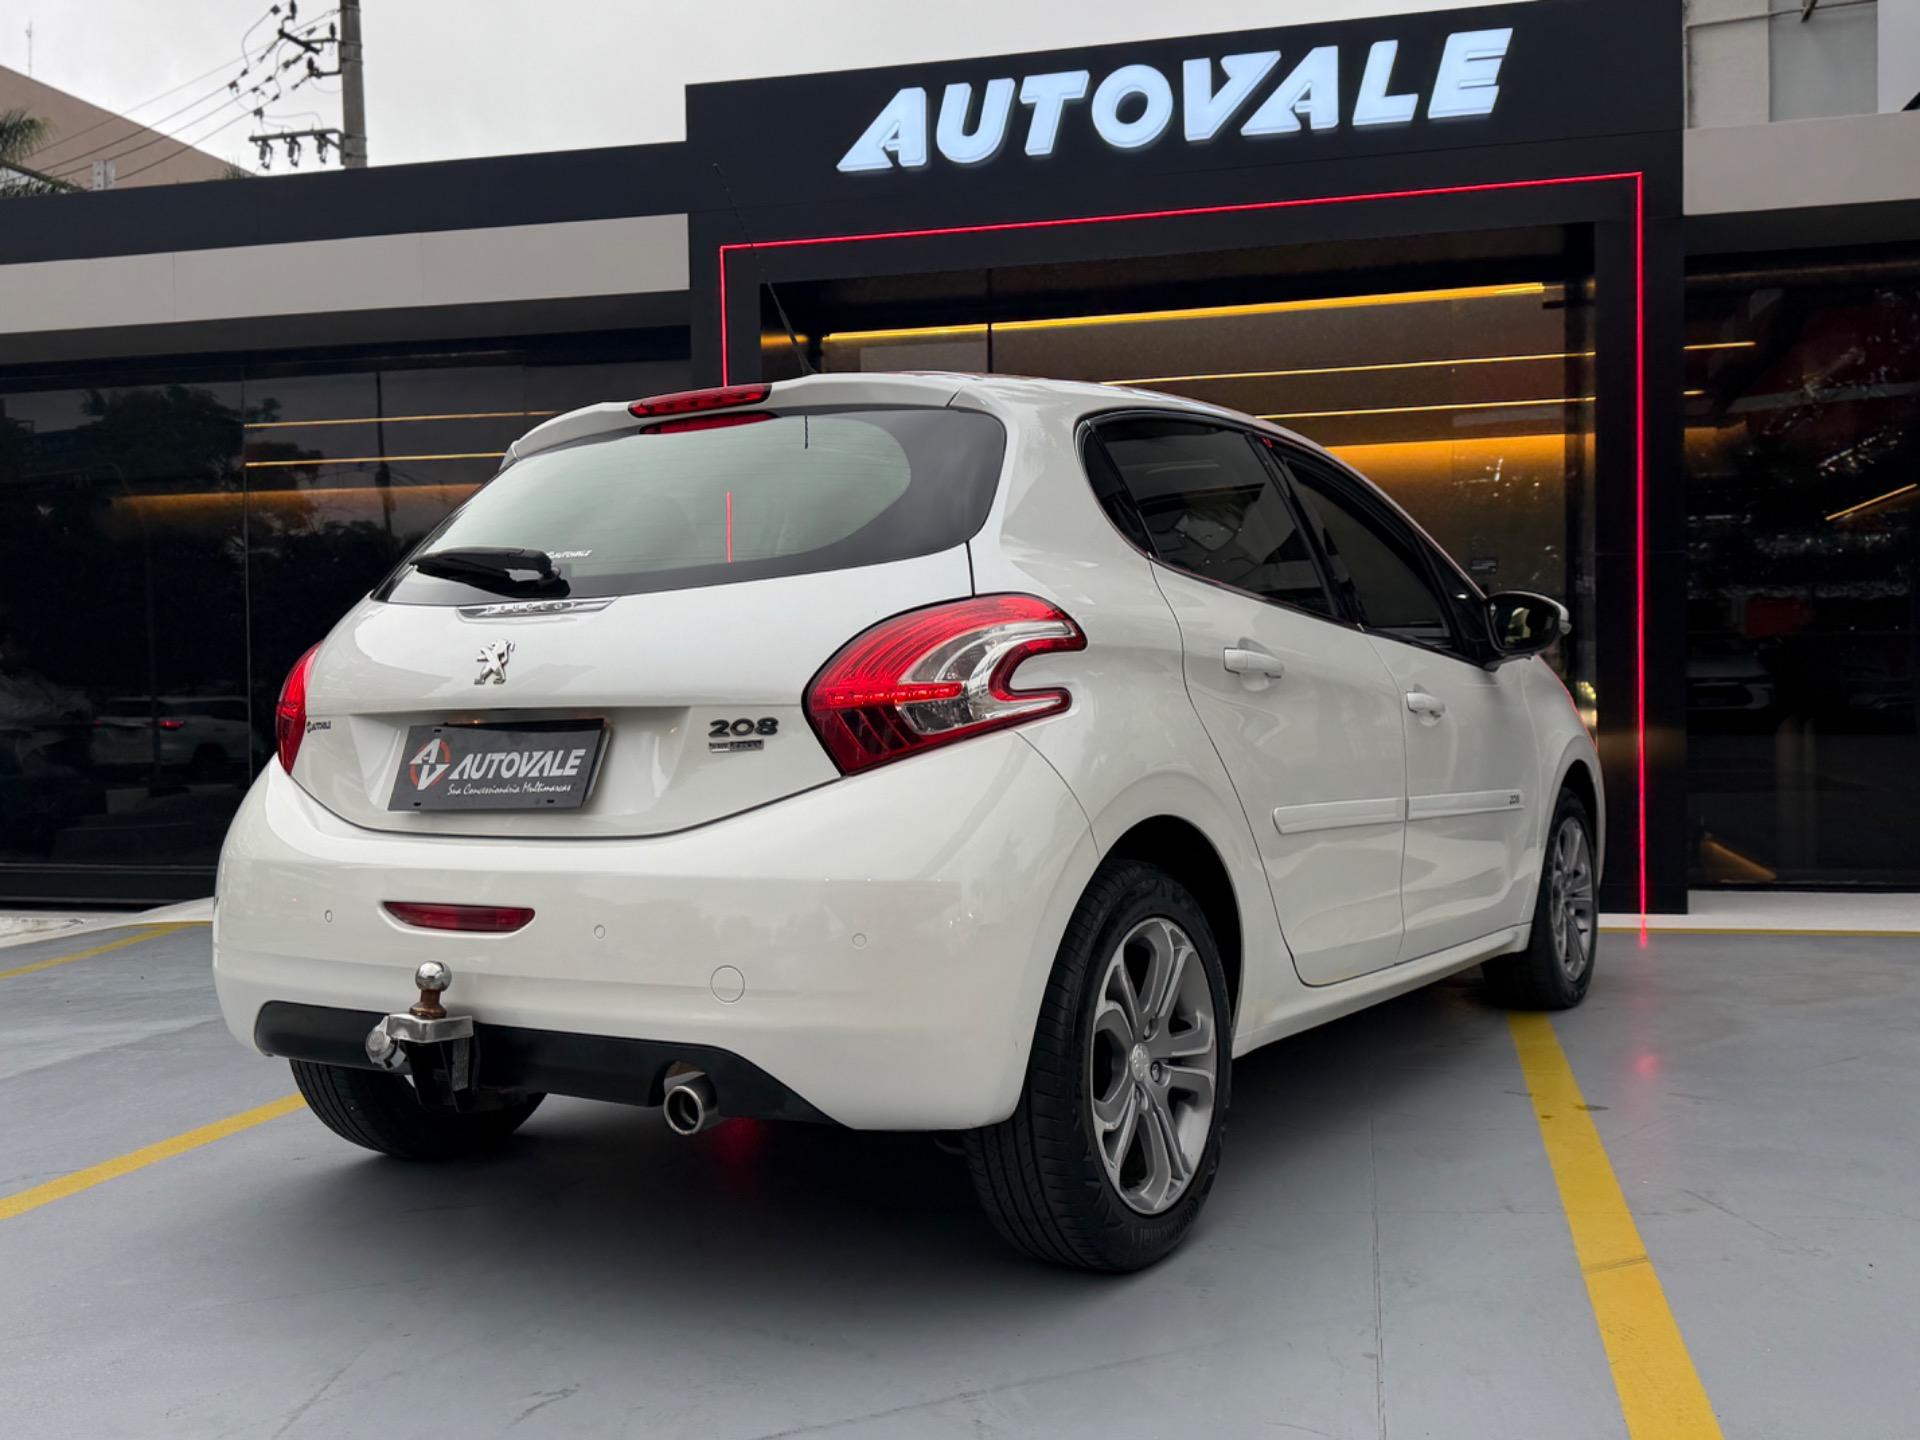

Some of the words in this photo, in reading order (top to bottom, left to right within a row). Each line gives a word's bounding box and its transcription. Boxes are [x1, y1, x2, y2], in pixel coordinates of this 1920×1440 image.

[836, 27, 1514, 173] AUTOVALE
[708, 716, 779, 738] 208
[448, 749, 586, 780] AUTOVALE
[447, 783, 461, 796] Sua
[521, 781, 571, 793] Multimarcas
